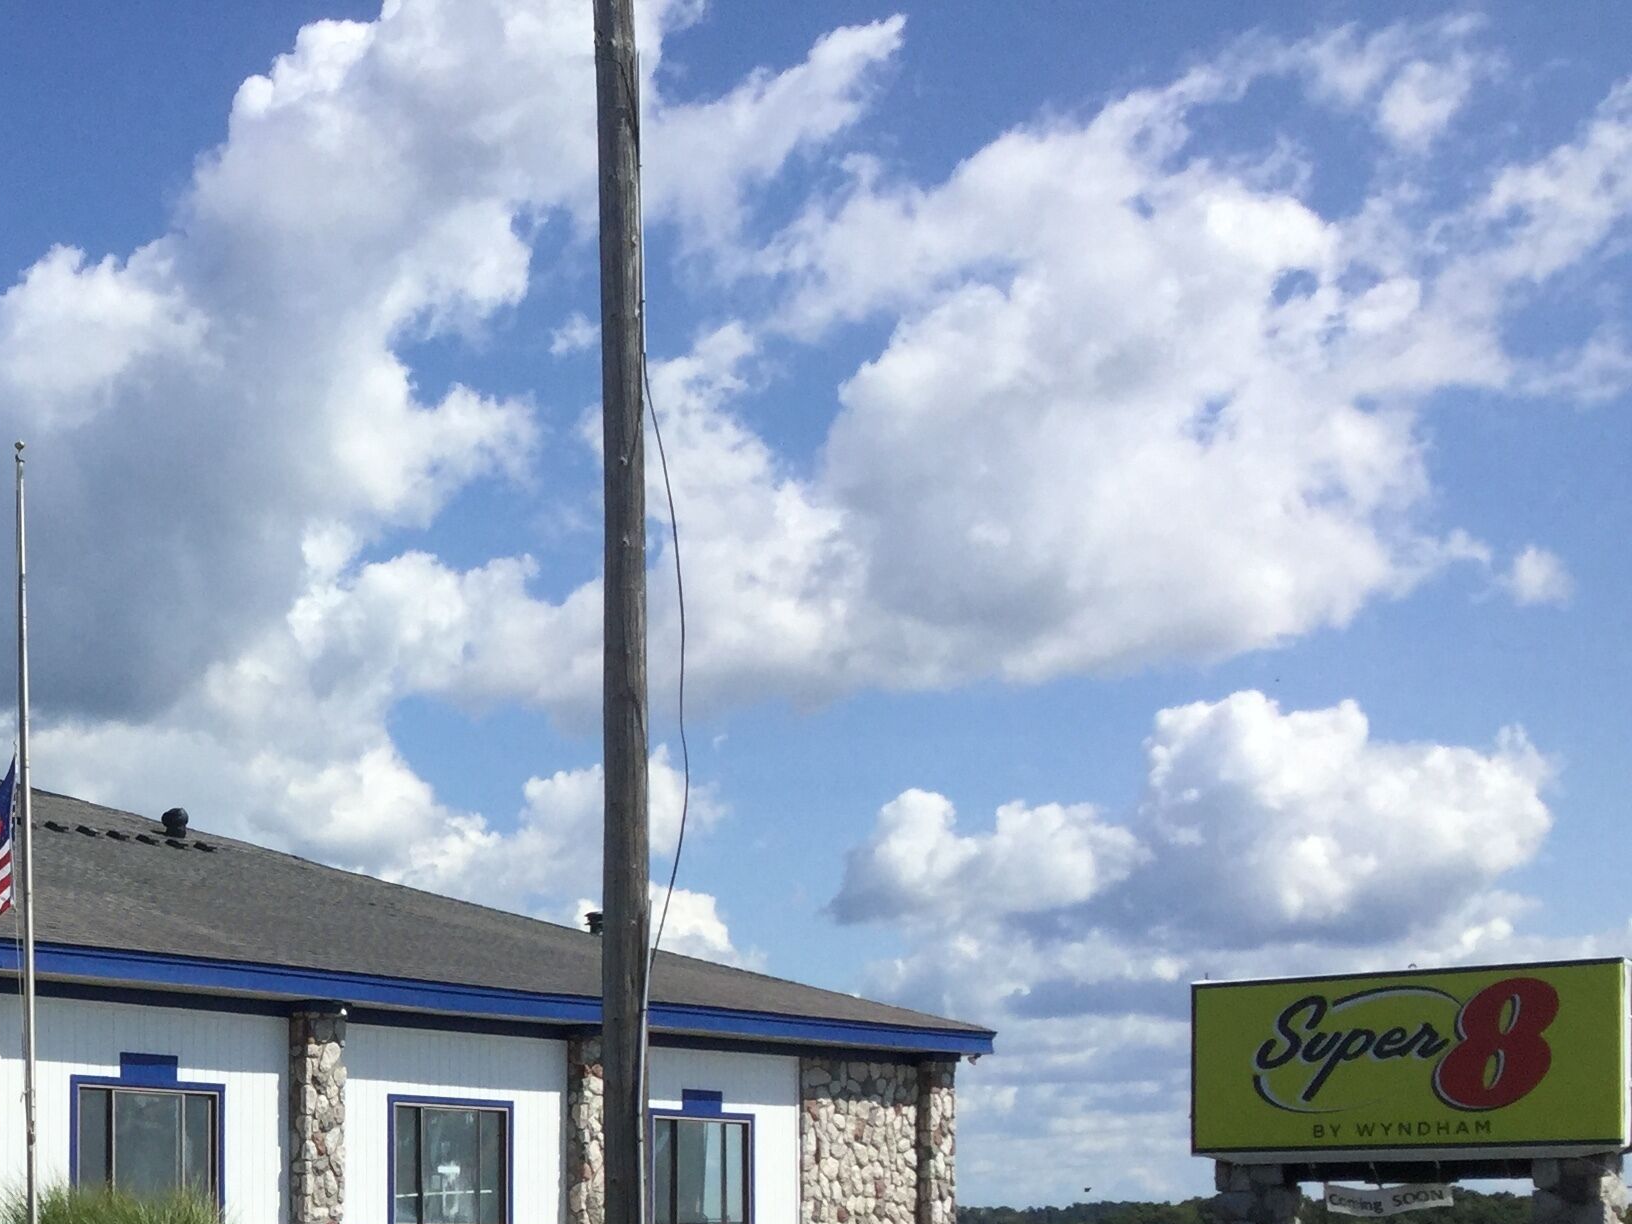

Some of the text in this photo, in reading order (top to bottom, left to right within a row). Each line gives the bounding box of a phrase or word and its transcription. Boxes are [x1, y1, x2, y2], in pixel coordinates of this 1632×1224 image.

[1254, 976, 1561, 1113] Super 8
[1312, 1118, 1492, 1139] BY WYNDHAM
[1328, 1192, 1385, 1214] Coming
